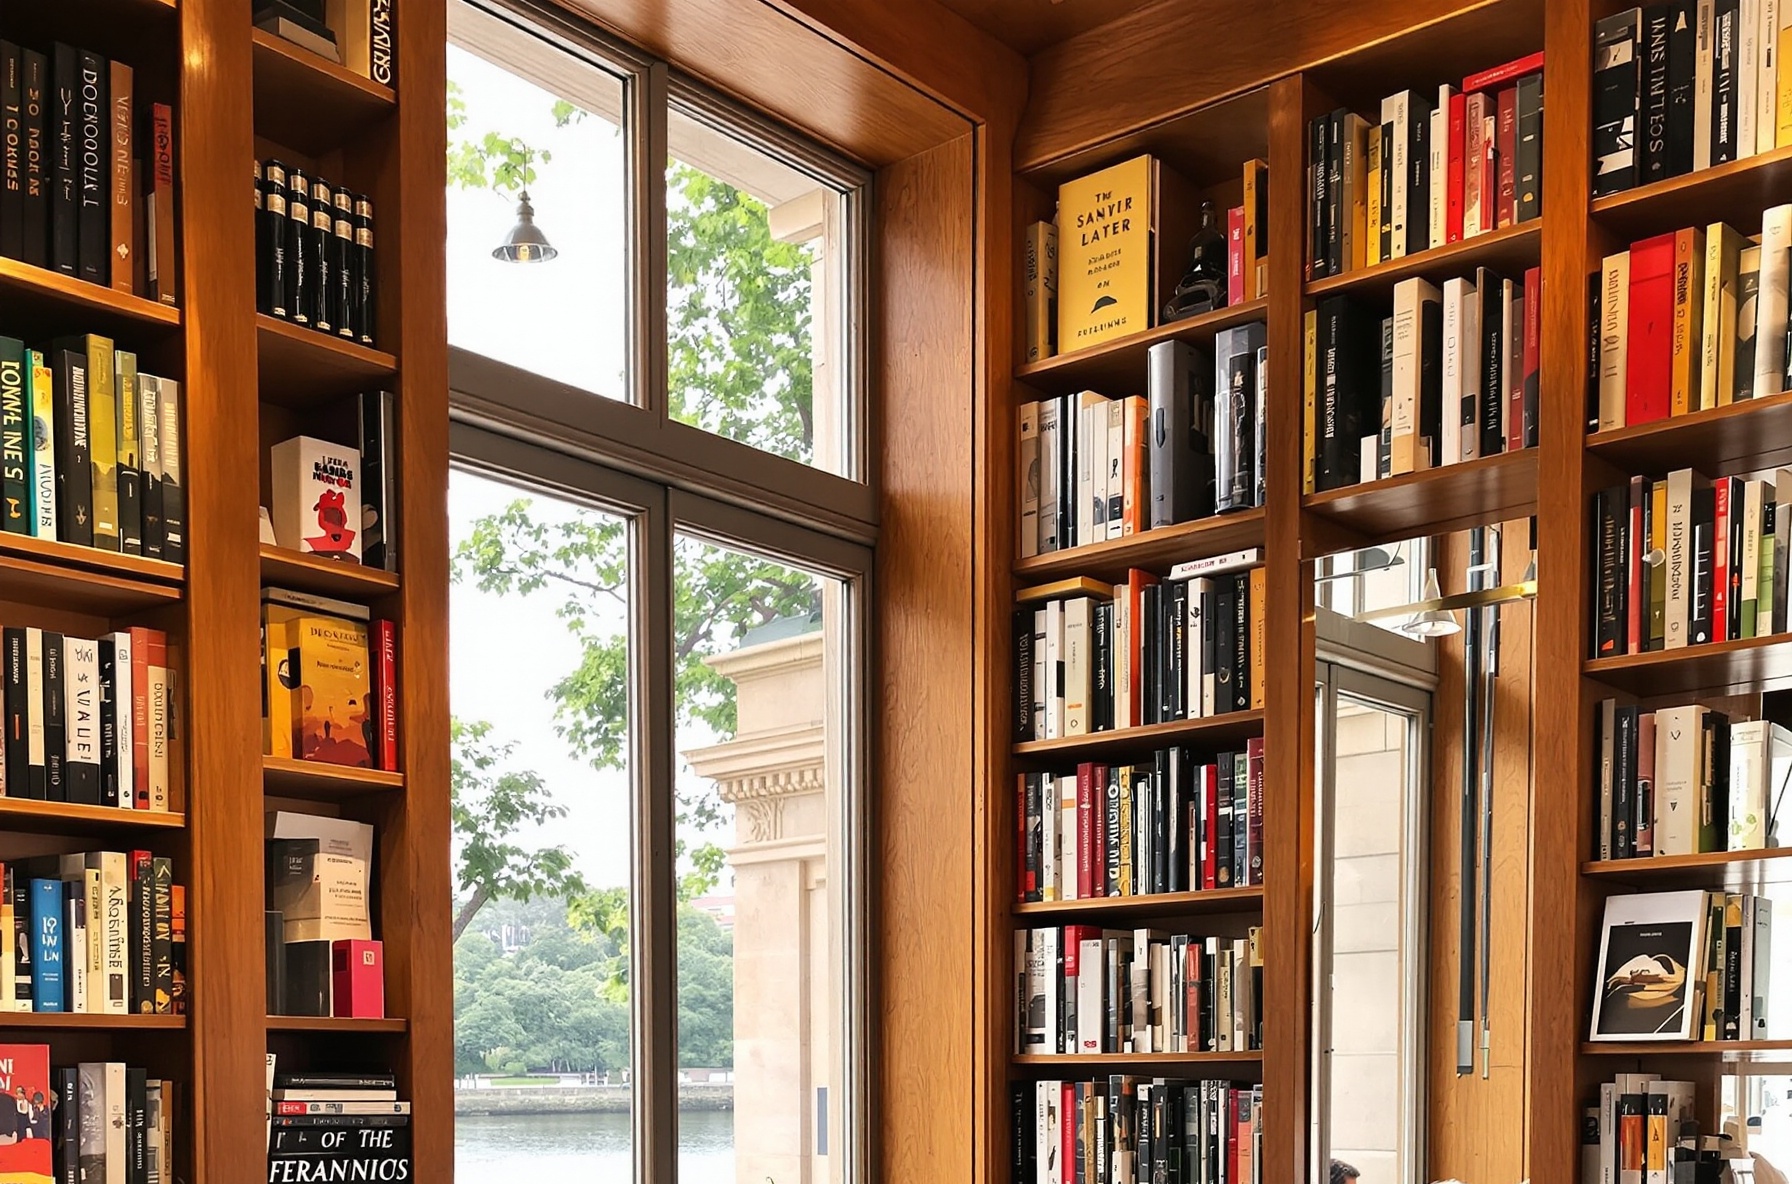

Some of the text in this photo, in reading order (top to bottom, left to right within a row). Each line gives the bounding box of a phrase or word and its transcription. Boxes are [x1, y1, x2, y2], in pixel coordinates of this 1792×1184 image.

[1081, 218, 1131, 247] LATER
[321, 1131, 347, 1149] OF
[358, 1129, 394, 1149] THE
